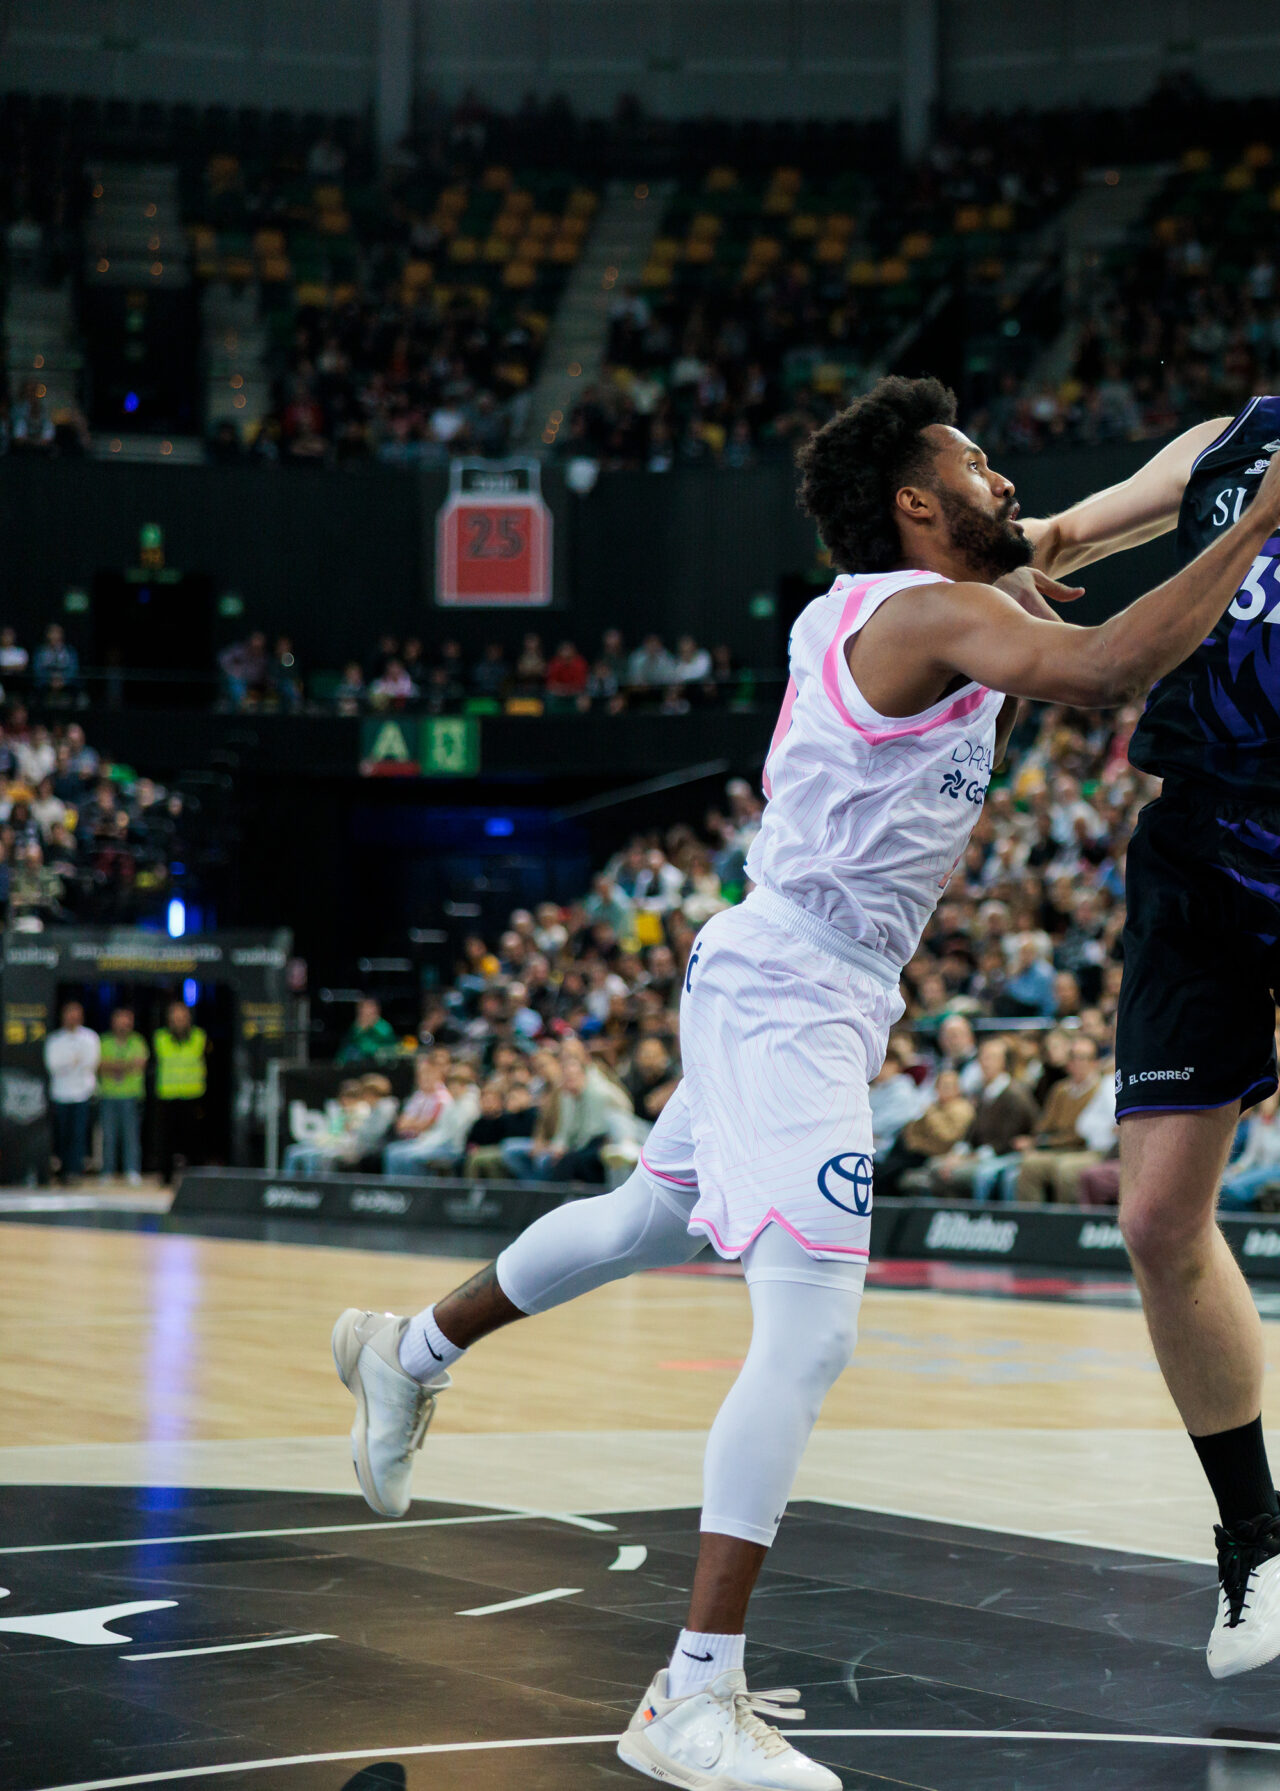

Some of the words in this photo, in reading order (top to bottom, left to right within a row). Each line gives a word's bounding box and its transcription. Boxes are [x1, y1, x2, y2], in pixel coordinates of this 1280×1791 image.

[463, 512, 524, 561] 25
[372, 720, 409, 762] A
[1128, 1073, 1139, 1086] EL
[1139, 1070, 1191, 1082] CORREO
